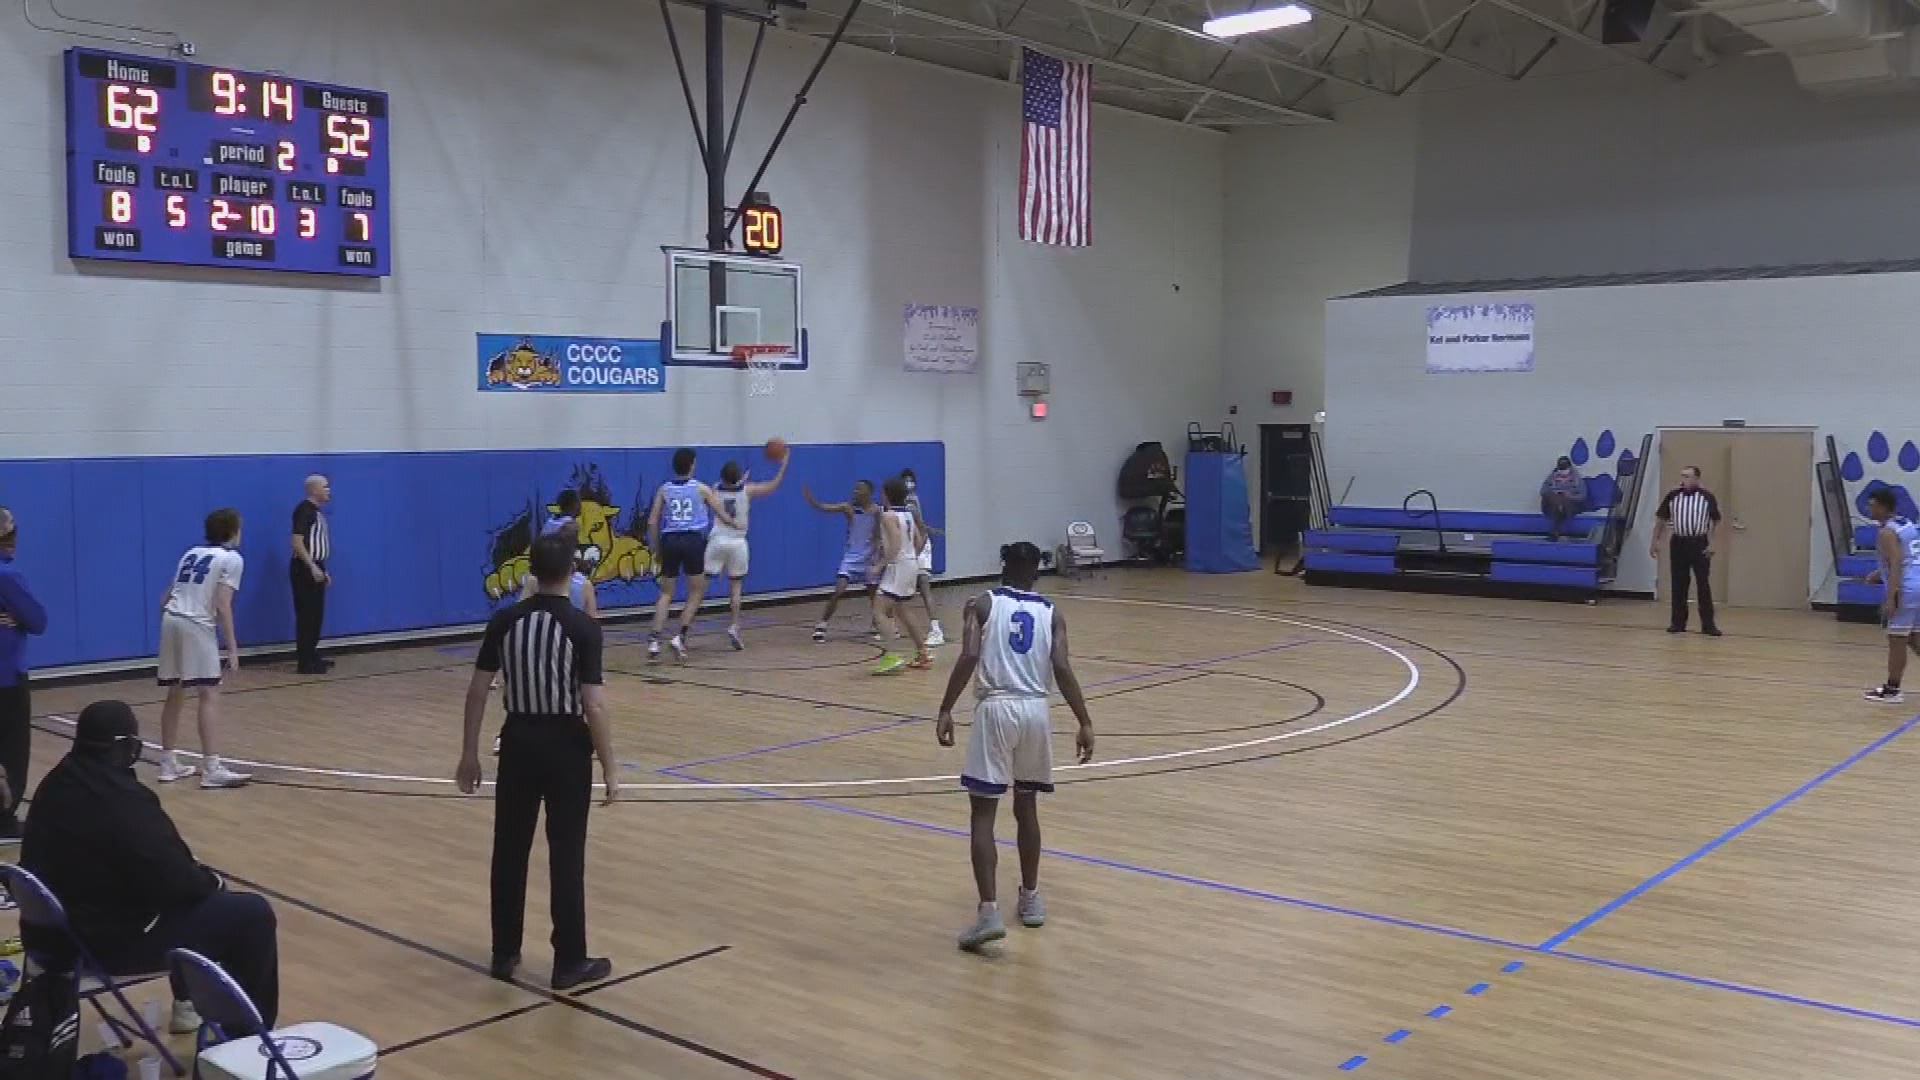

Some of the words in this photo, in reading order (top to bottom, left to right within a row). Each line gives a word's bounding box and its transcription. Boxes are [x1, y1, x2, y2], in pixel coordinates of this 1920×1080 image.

[107, 59, 149, 83] Home
[106, 85, 158, 131] 62
[322, 91, 368, 114] Guests
[327, 115, 370, 156] 52
[220, 145, 265, 163] period
[277, 141, 294, 171] 2
[98, 163, 136, 185] fouls
[219, 175, 267, 196] player
[111, 190, 131, 223] 8
[341, 187, 372, 207] fouls
[167, 195, 186, 227] 5
[300, 207, 315, 237] 3
[103, 231, 134, 247] won
[353, 213, 368, 241] 7
[745, 209, 779, 248] 20
[226, 240, 263, 258] game
[345, 249, 371, 264] won
[566, 344, 622, 363] CCCC
[567, 366, 659, 385] COUGARS
[671, 498, 693, 520] 22
[177, 553, 214, 585] 24
[1009, 611, 1035, 655] 3
